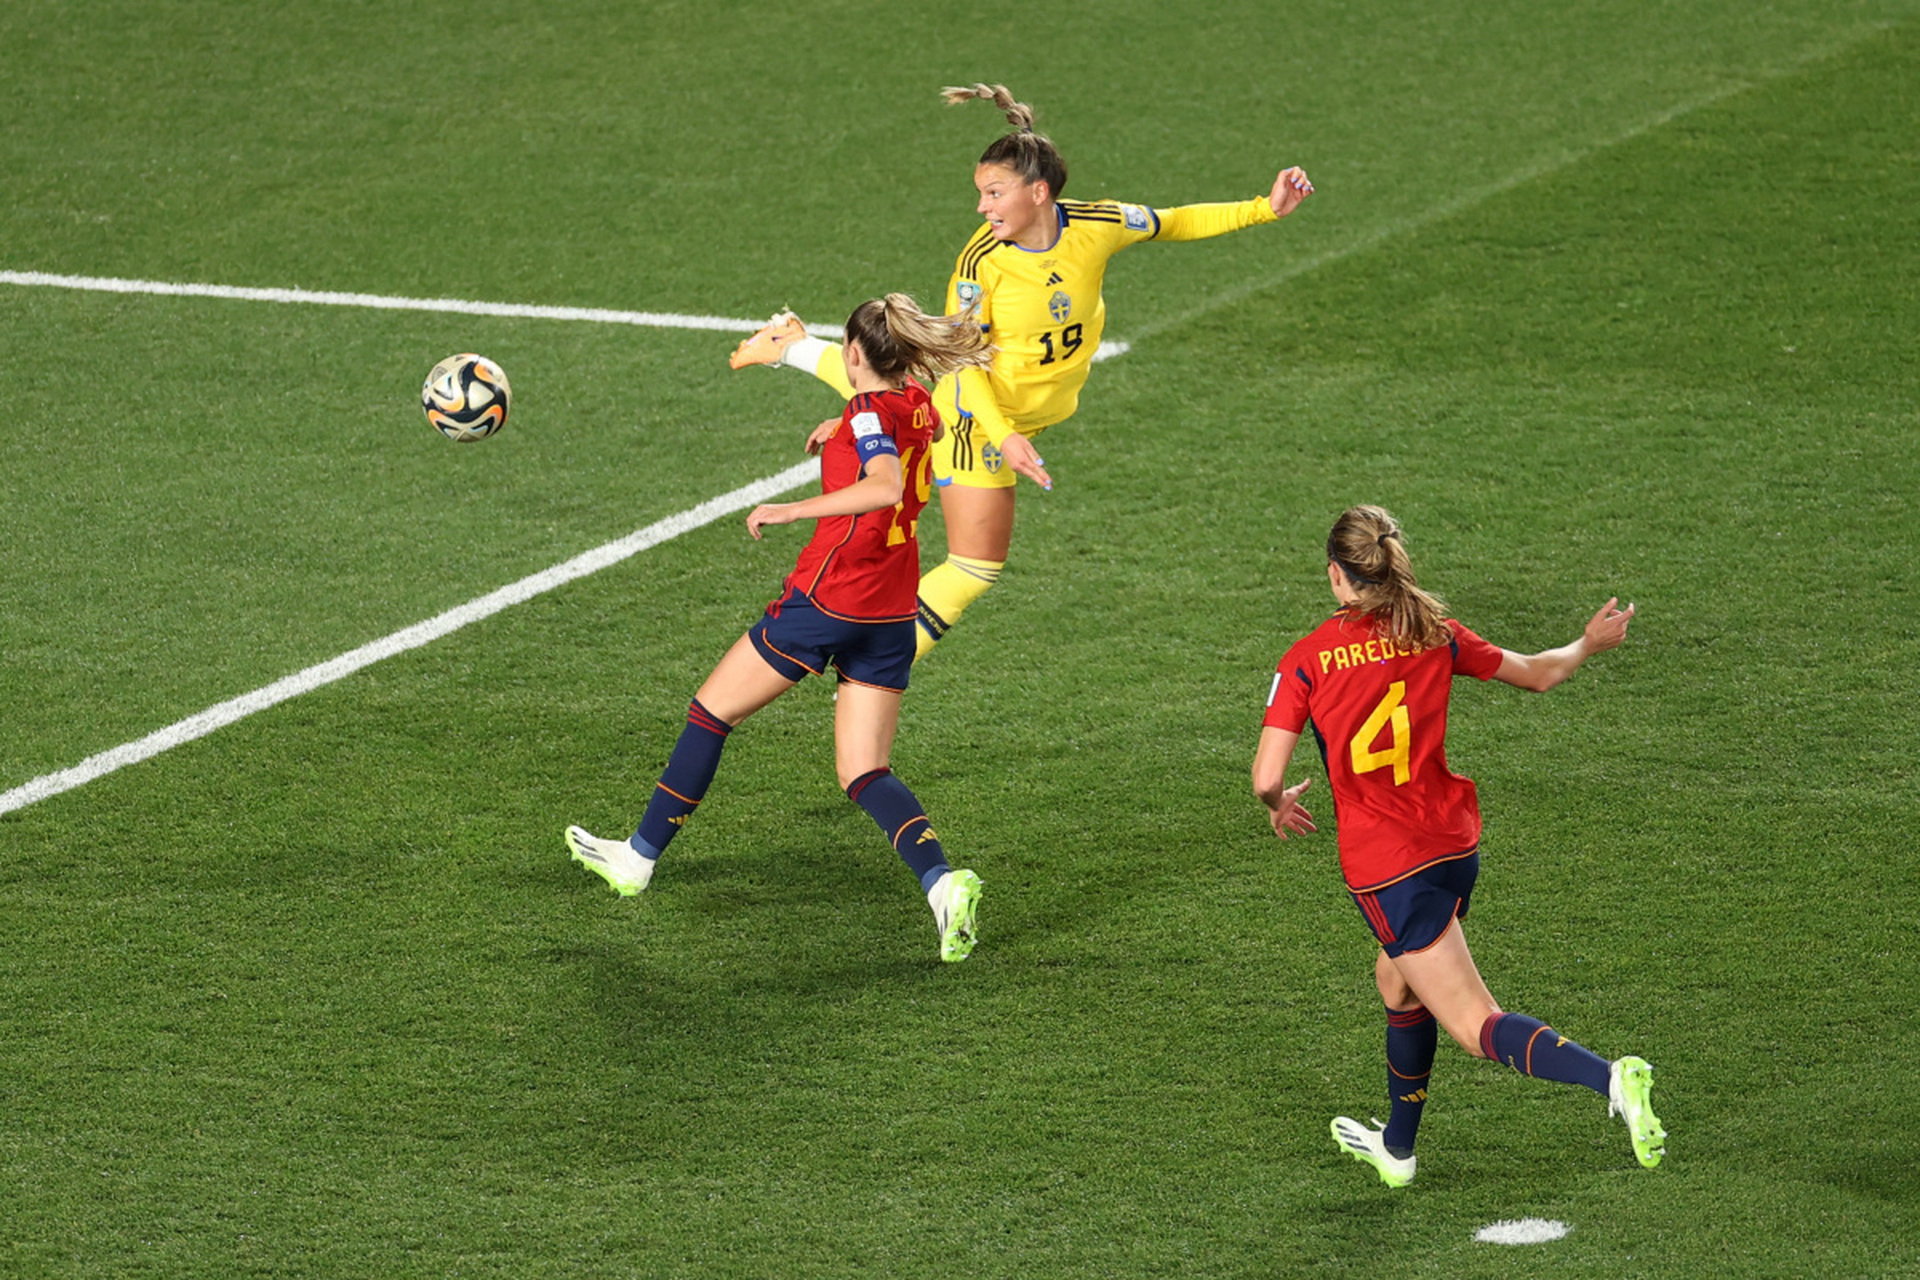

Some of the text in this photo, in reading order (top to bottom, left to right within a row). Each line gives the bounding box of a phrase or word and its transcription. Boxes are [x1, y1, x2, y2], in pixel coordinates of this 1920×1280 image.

[1039, 322, 1083, 365] 19
[1318, 638, 1422, 675] PARED
[1350, 680, 1411, 787] 4
